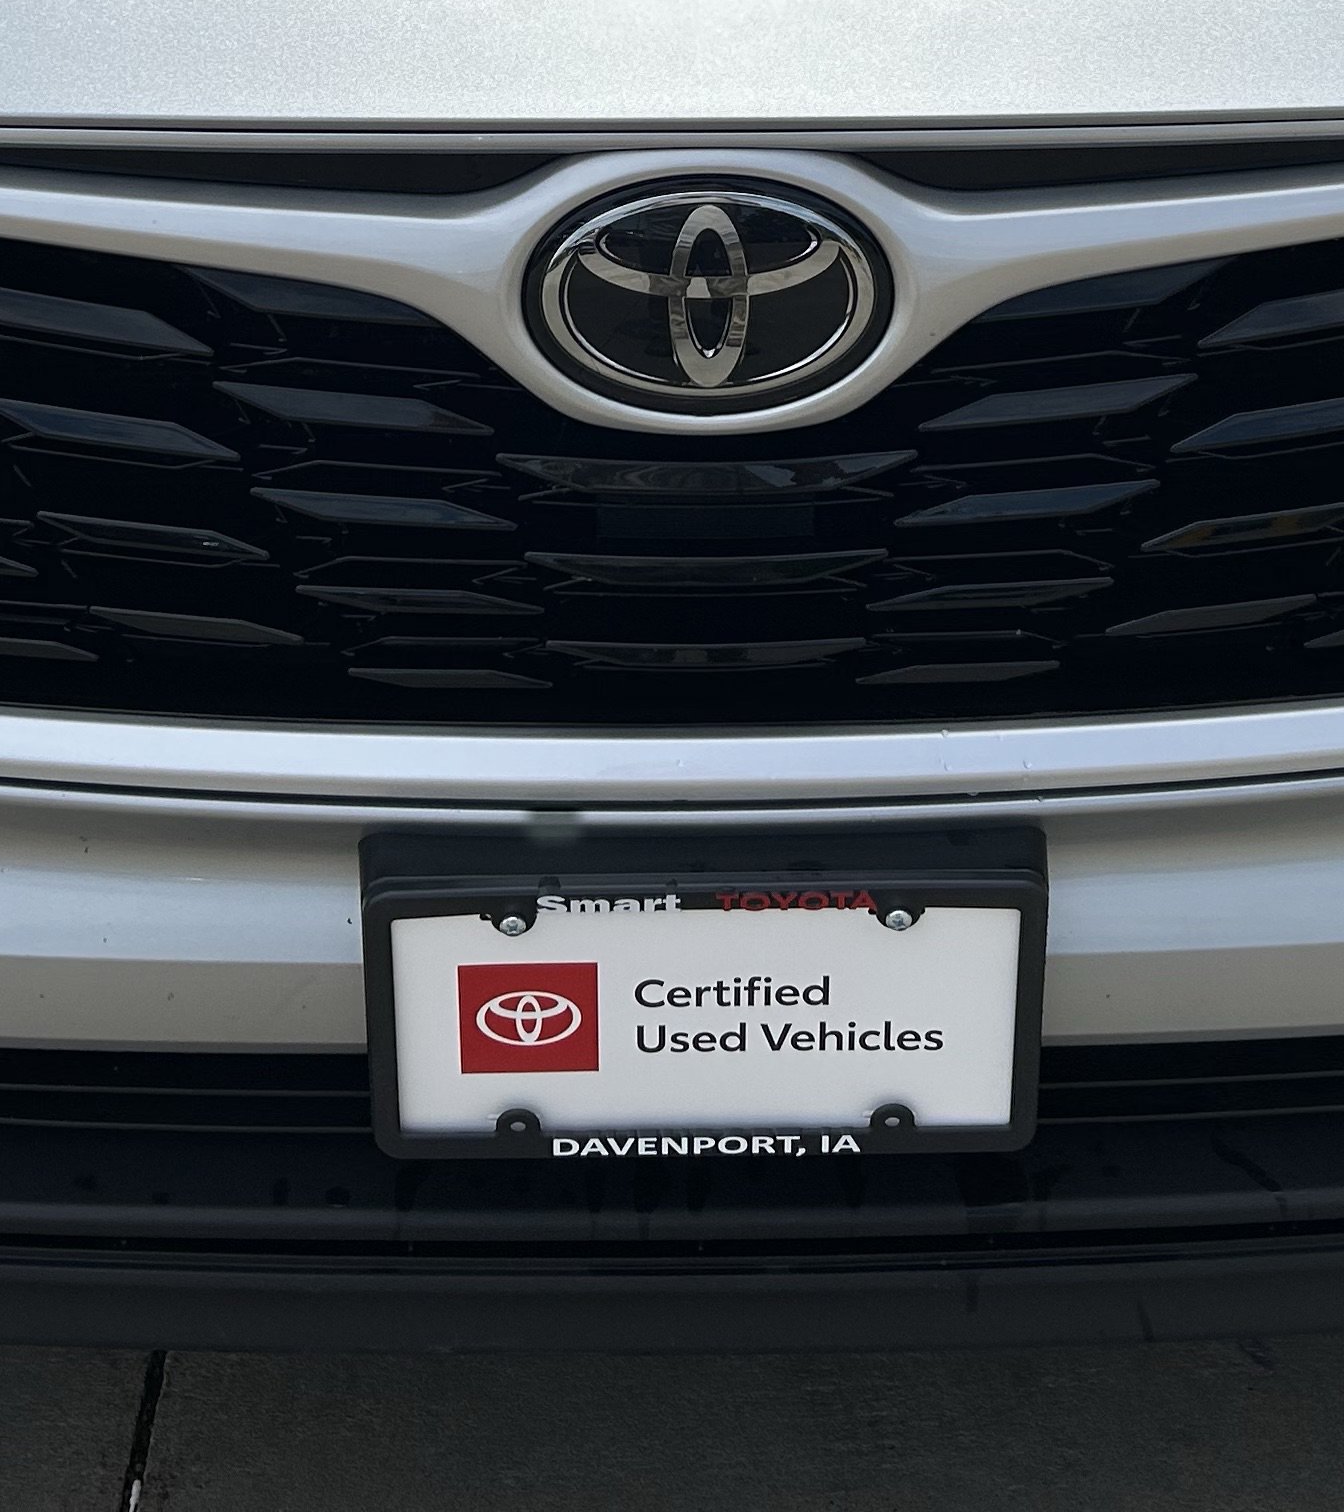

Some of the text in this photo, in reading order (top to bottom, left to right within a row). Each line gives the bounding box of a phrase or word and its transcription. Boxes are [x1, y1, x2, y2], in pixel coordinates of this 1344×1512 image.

[536, 889, 878, 914] Smart TOYOTA
[634, 975, 831, 1008] Certified
[636, 1020, 944, 1053] Used Vehicles
[552, 1133, 861, 1157] DAVENPORT, IA
